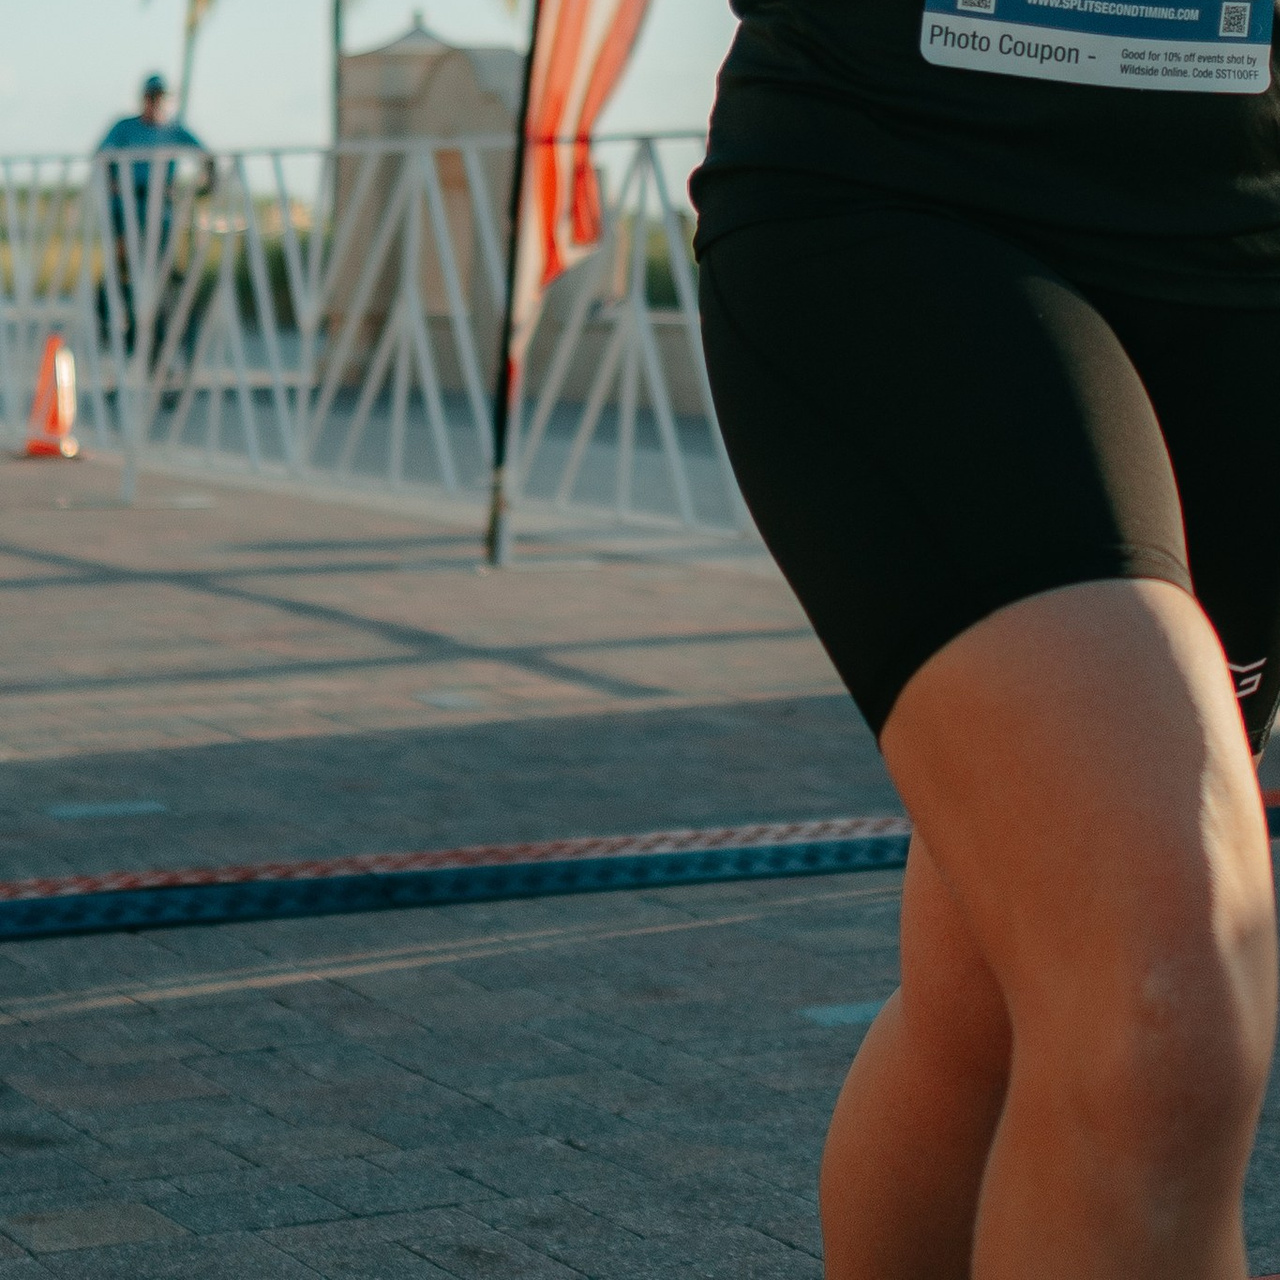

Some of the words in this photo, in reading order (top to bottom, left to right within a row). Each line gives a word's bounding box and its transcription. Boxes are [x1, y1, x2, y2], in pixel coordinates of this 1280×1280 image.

[929, 24, 991, 52] Photo
[998, 33, 1080, 64] Coupon
[1121, 48, 1146, 61] Good
[1148, 51, 1160, 62] for
[1164, 51, 1182, 63] 10%
[1184, 52, 1196, 63] off
[1197, 53, 1225, 65] events
[1226, 54, 1245, 65] shot
[1247, 55, 1257, 67] by
[1120, 64, 1160, 77] Wildside
[1192, 68, 1214, 79] Code
